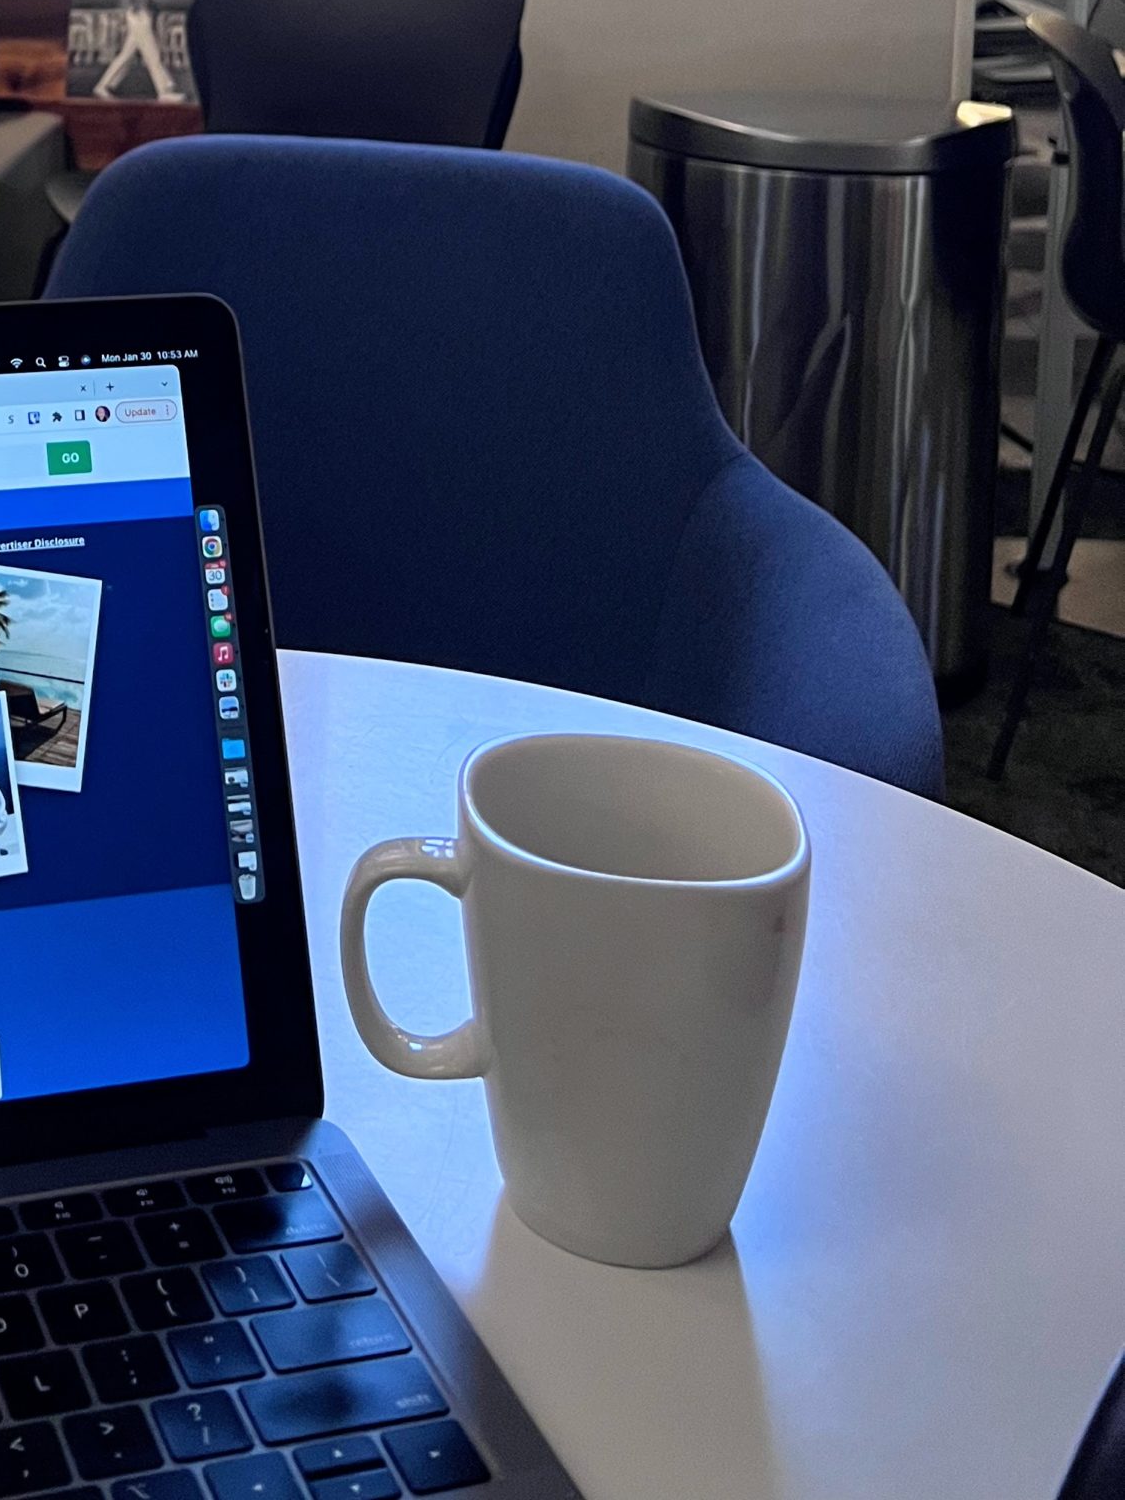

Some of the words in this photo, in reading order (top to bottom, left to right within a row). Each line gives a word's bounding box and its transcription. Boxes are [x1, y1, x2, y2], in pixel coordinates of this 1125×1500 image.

[100, 352, 121, 363] Mon
[121, 352, 139, 362] Jan
[139, 350, 153, 361] 30
[156, 349, 183, 360] 10:53
[182, 348, 199, 359] AM
[60, 451, 80, 464] GO
[33, 534, 85, 550] Disclosure
